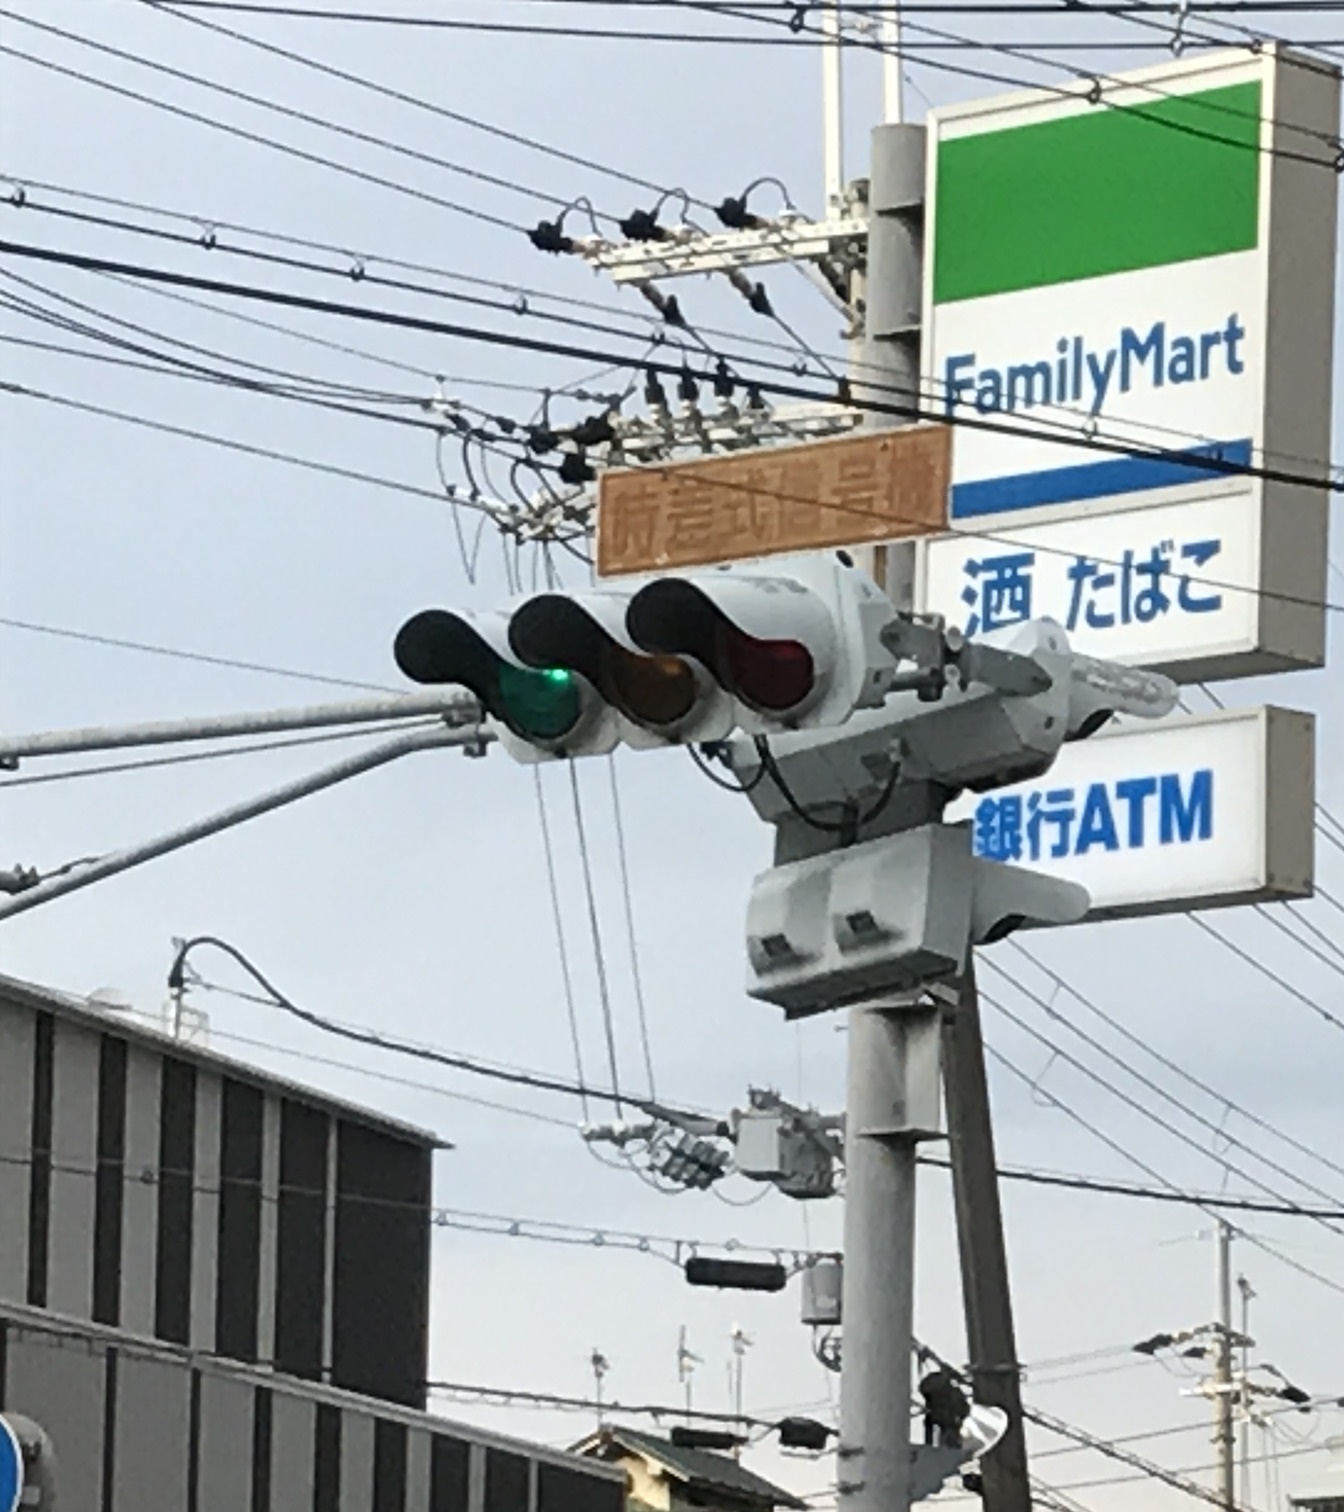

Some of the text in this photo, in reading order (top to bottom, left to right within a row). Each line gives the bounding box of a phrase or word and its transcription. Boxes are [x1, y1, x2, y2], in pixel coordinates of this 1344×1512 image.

[945, 312, 1246, 418] FamilyMart
[961, 538, 1222, 638] 酒 たばこ
[974, 768, 1214, 861] 銀行ATM
